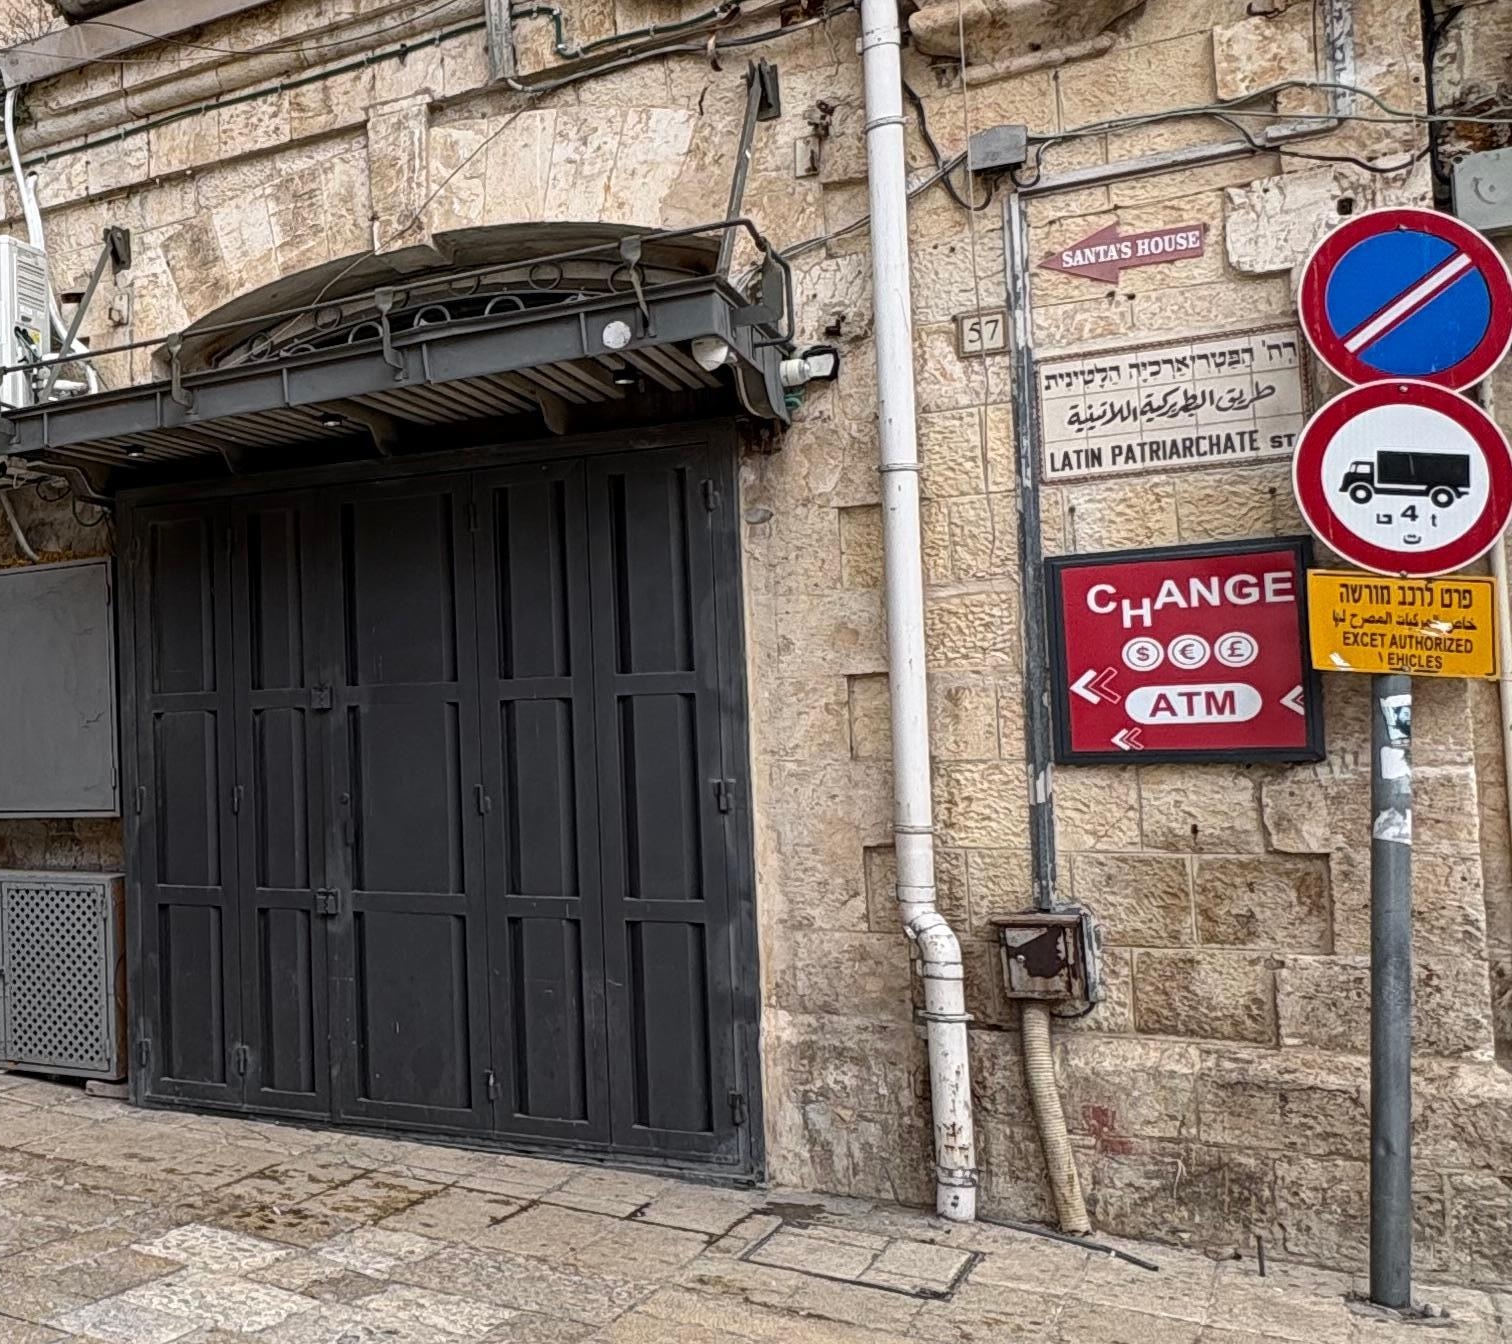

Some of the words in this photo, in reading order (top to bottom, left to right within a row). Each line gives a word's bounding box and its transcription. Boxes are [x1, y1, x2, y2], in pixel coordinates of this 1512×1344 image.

[1061, 239, 1132, 268] SANTA'S
[1136, 231, 1201, 257] HOUSE
[968, 319, 1000, 344] 57
[1216, 381, 1277, 412] طريق
[1067, 400, 1138, 433] اللاتينية
[1049, 446, 1103, 473] LATIN
[1111, 429, 1260, 466] PATRIARCHATE
[1400, 505, 1419, 522] 4
[1086, 570, 1296, 629] CHANGE
[1339, 583, 1391, 605] מורשה
[1398, 582, 1434, 607] לרכב
[1441, 588, 1473, 609] פרט
[1135, 646, 1150, 662] $
[1178, 643, 1195, 660] €
[1227, 640, 1244, 657] £
[1342, 631, 1387, 648] EXCET
[1389, 633, 1473, 654] AUTHORIZED
[1148, 690, 1237, 718] ATM
